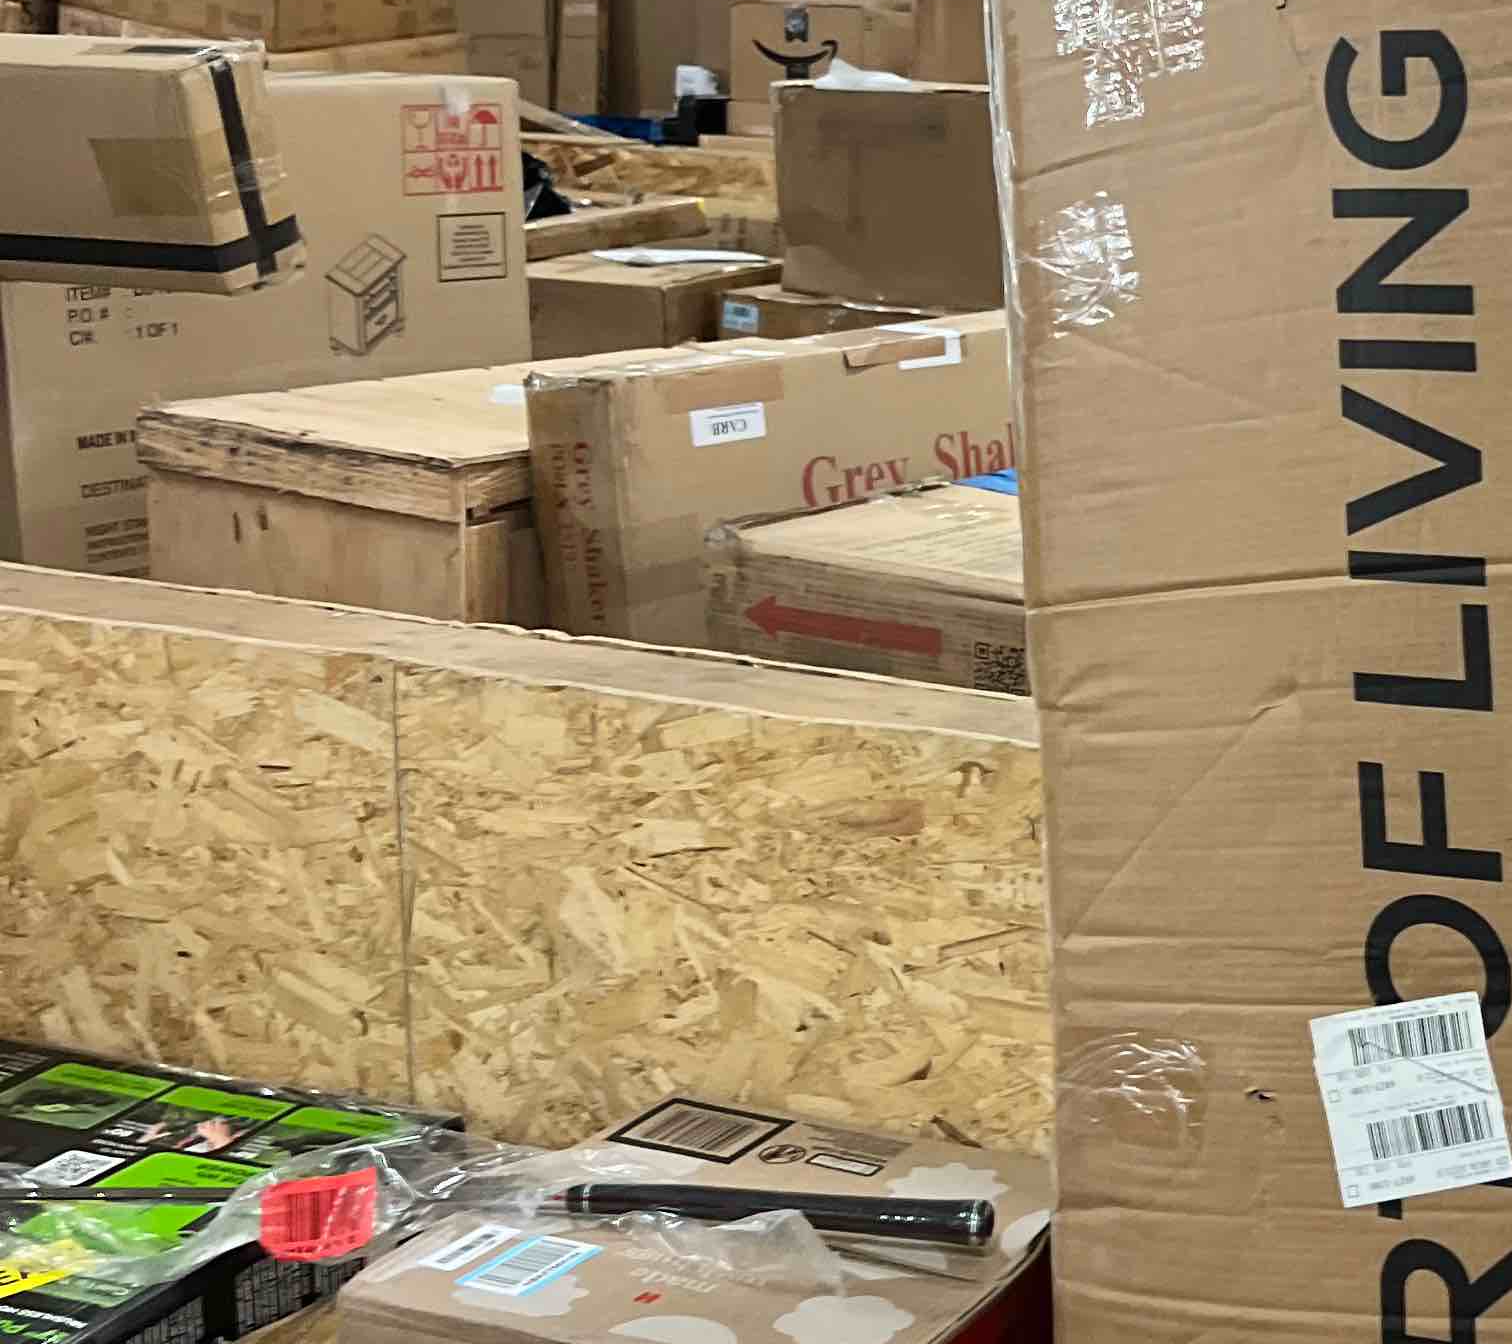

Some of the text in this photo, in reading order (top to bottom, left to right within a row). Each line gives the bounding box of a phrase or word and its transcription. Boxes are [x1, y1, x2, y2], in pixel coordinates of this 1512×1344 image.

[803, 456, 910, 507] Grey
[1324, 29, 1494, 713] LIVING
[1358, 761, 1512, 1038] OF
